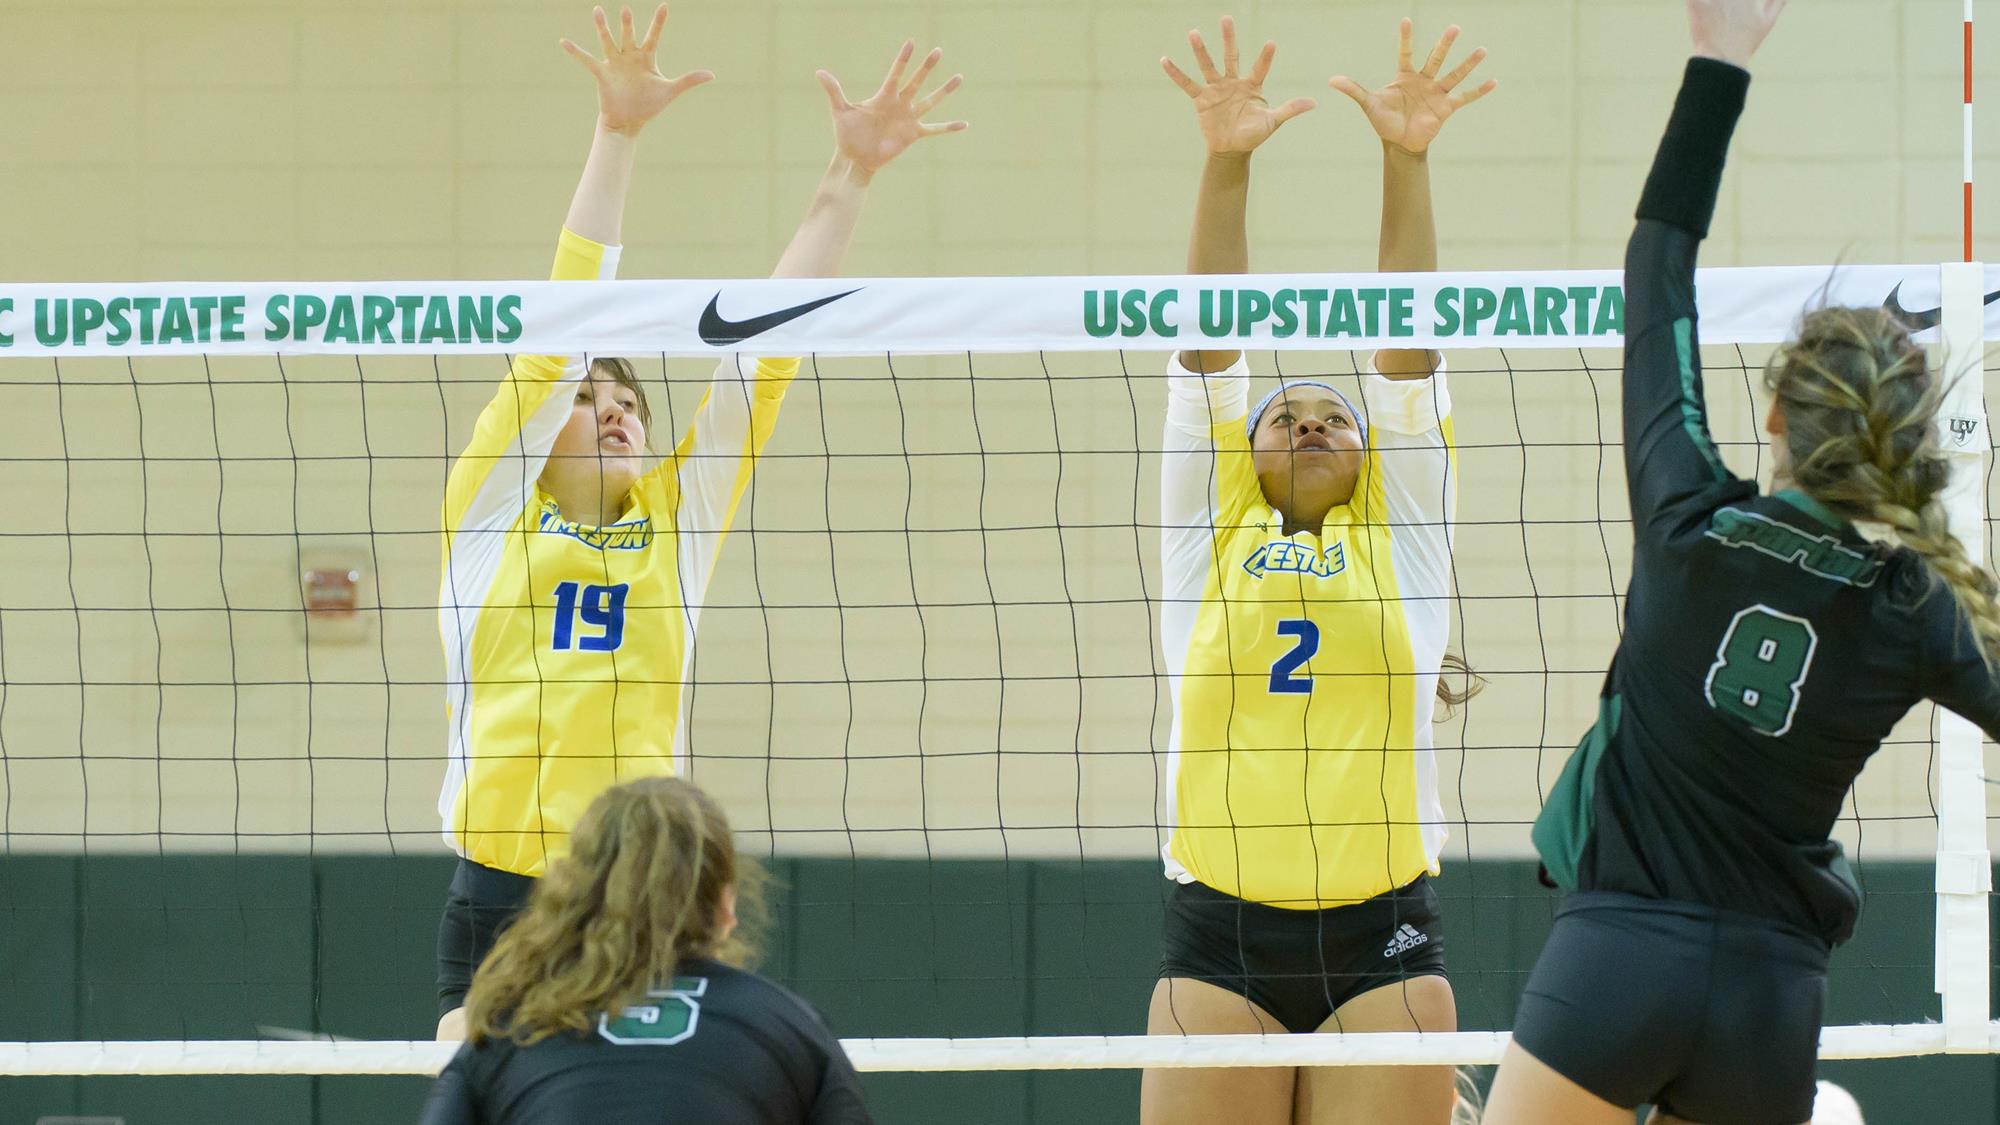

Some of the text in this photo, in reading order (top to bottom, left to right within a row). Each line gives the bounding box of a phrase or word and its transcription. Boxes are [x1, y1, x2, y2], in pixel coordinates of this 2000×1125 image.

[34, 295, 245, 347] UPSTATE
[264, 293, 523, 345] SPARTANS
[1083, 285, 1626, 338] USC UPSTATE SPARTA
[552, 581, 630, 652] 19
[1268, 619, 1320, 694] 2
[1704, 603, 1819, 737] 8
[1383, 933, 1428, 958] adidas
[598, 976, 708, 1045] 5
